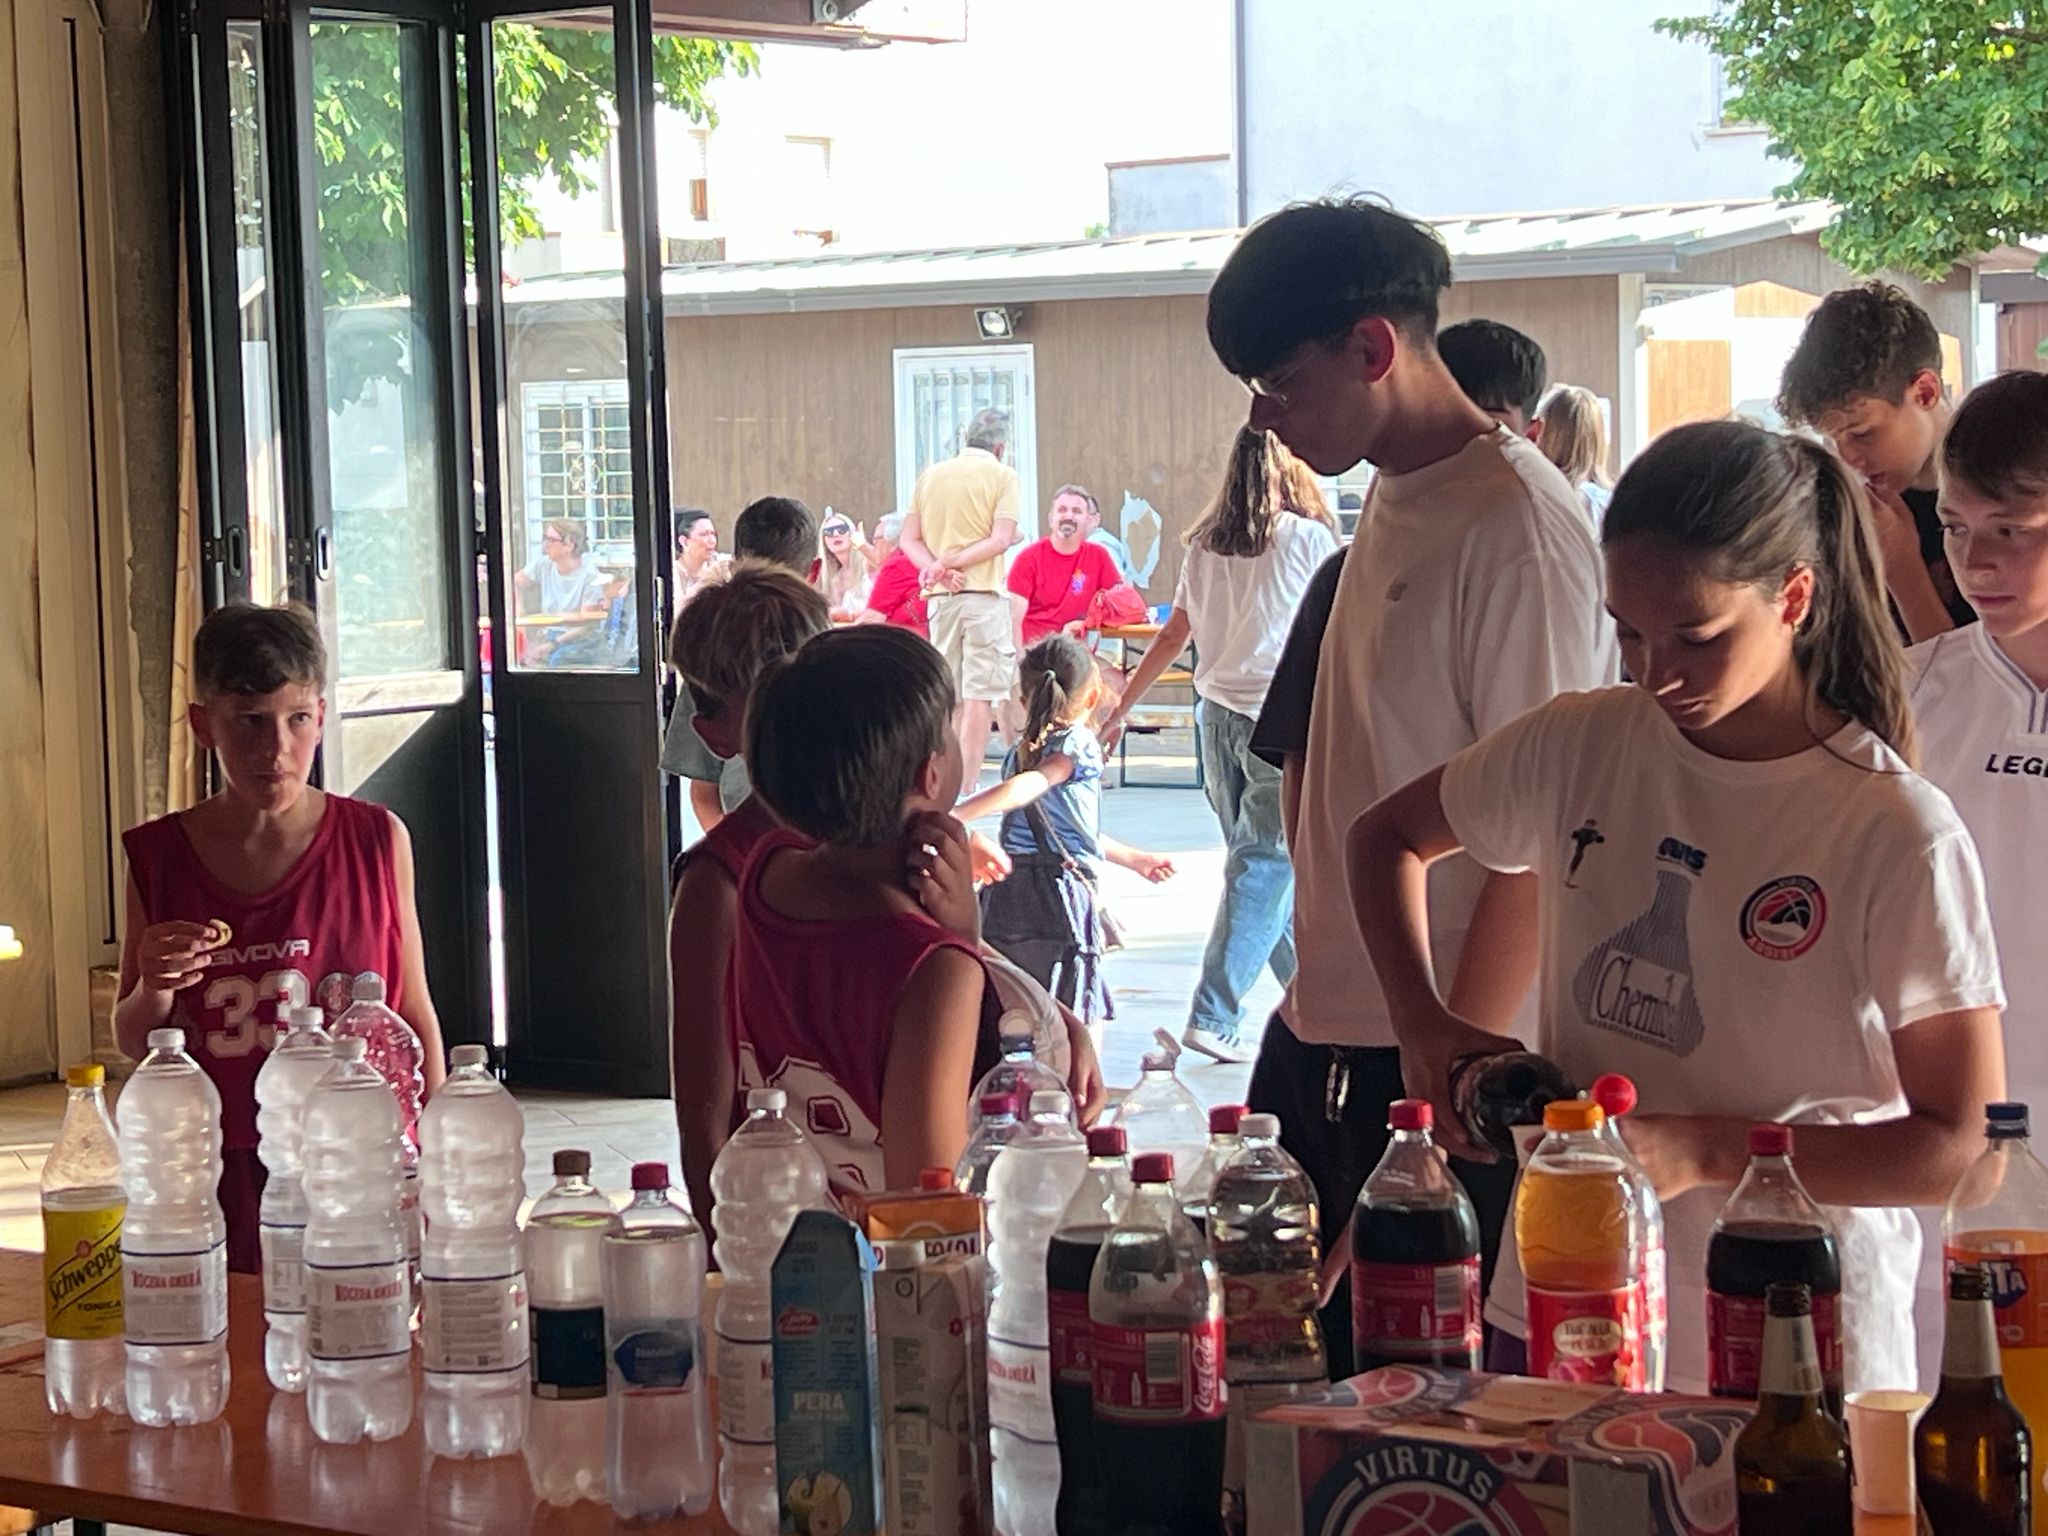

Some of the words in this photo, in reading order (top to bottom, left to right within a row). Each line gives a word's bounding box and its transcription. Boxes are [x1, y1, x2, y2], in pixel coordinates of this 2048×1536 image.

[203, 968, 311, 1058] 33
[793, 1391, 846, 1411] PERA
[1354, 1445, 1493, 1502] VIRTUS
